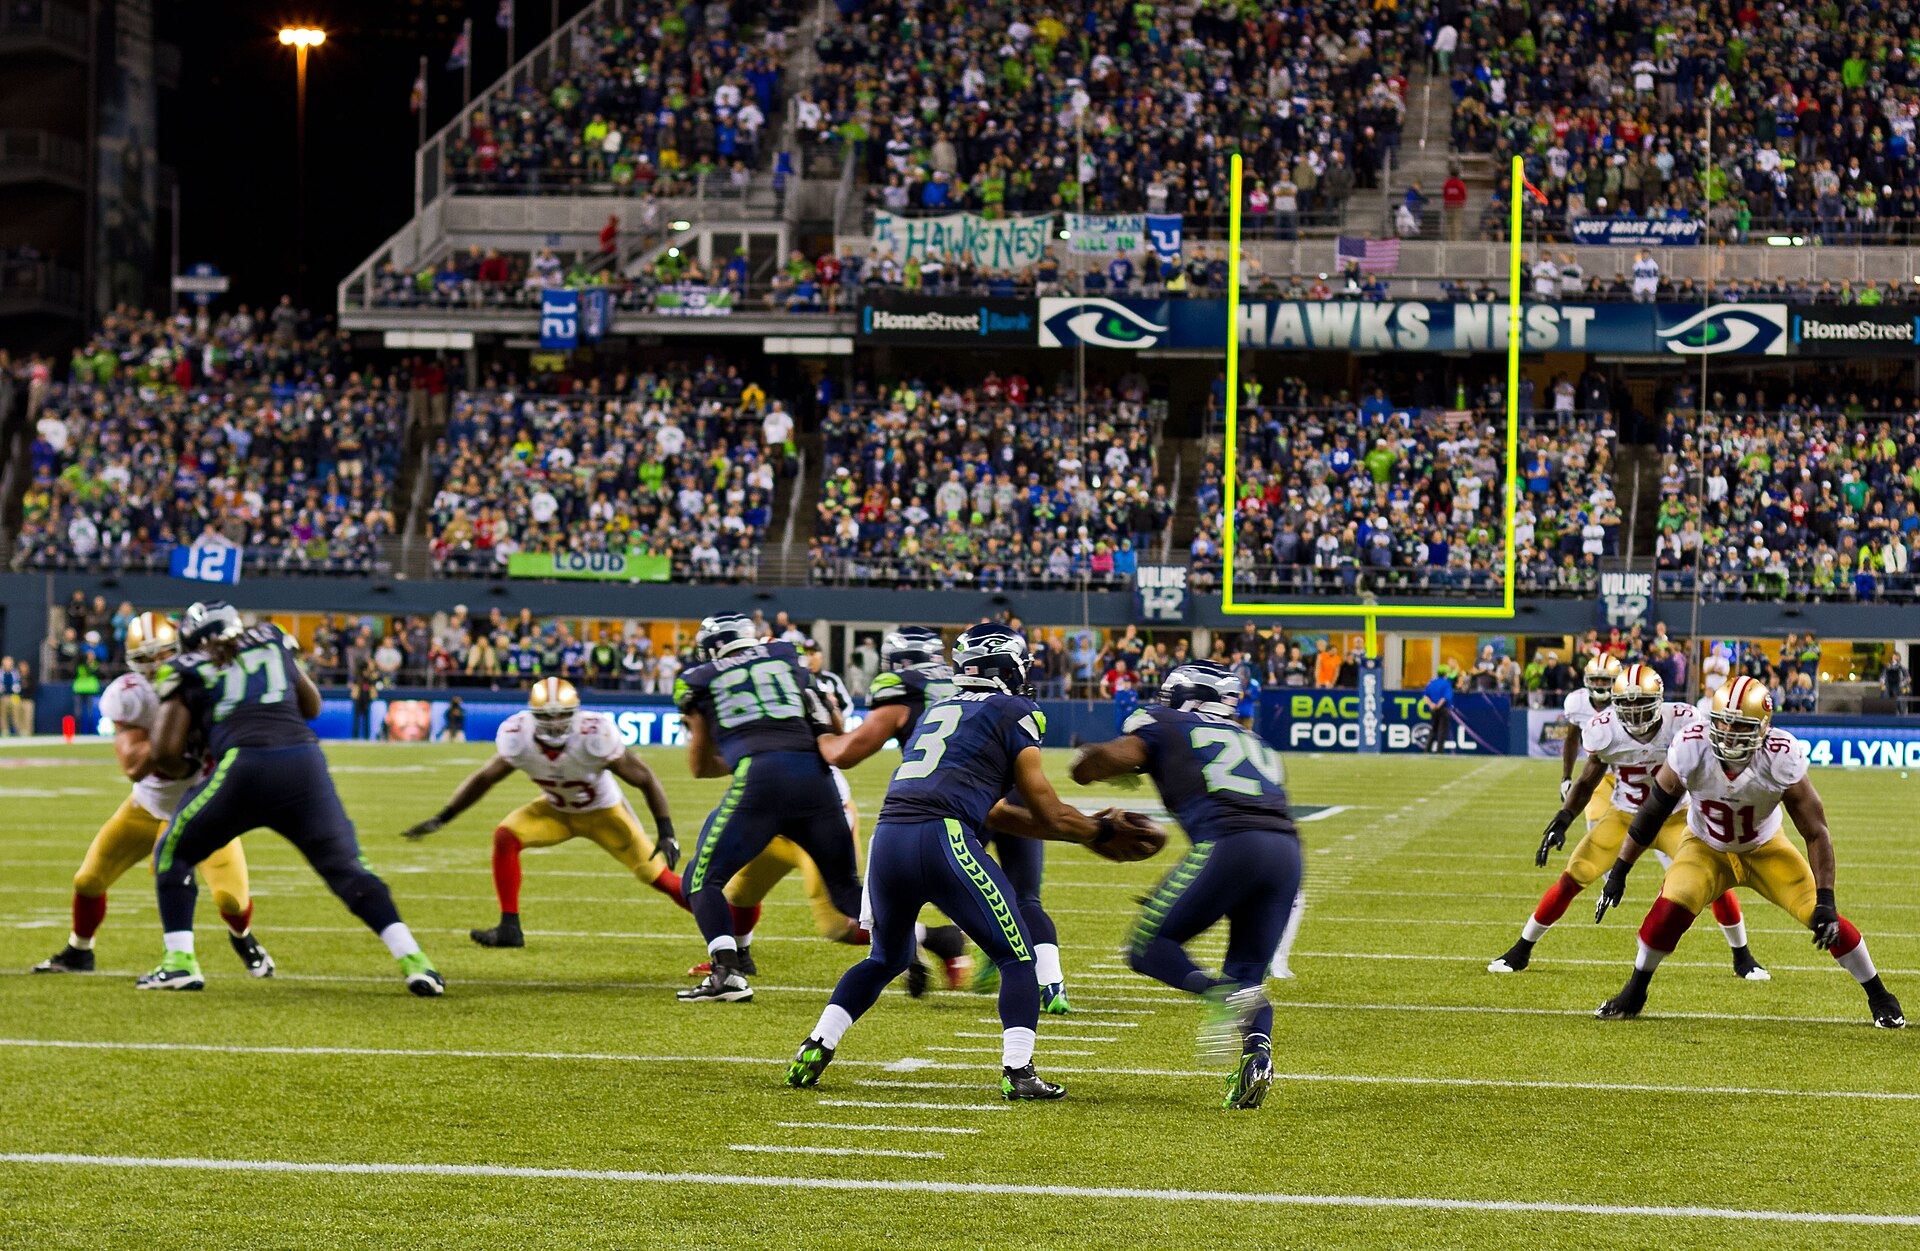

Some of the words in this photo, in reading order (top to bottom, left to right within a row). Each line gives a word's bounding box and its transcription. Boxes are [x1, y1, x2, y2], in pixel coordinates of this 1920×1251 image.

[906, 215, 991, 265] HAWKS
[993, 215, 1053, 268] NEST
[1573, 221, 1609, 234] JUST
[1610, 221, 1650, 235] MAKE
[1117, 236, 1136, 250] IN
[542, 301, 577, 339] 12
[873, 311, 980, 331] HomeStreet
[1238, 301, 1430, 350] HAWKS
[1454, 303, 1596, 350] NEST
[1803, 320, 1914, 340] HomeStreet
[182, 543, 227, 582] 12
[554, 551, 625, 573] LOUD
[1137, 566, 1187, 588] VOLUME
[1601, 572, 1652, 596] VOLUME
[197, 643, 288, 723] 77
[709, 660, 806, 729] 60
[1291, 695, 1384, 719] BAC
[895, 705, 964, 781] 3
[1290, 722, 1477, 750] FOOBL
[1683, 724, 1704, 742] 91
[1769, 736, 1791, 754] 91
[1189, 726, 1285, 797] 24
[1842, 740, 1920, 767] LYNC
[530, 778, 597, 808] 53
[1618, 765, 1663, 806] 5
[1701, 800, 1759, 844] 91
